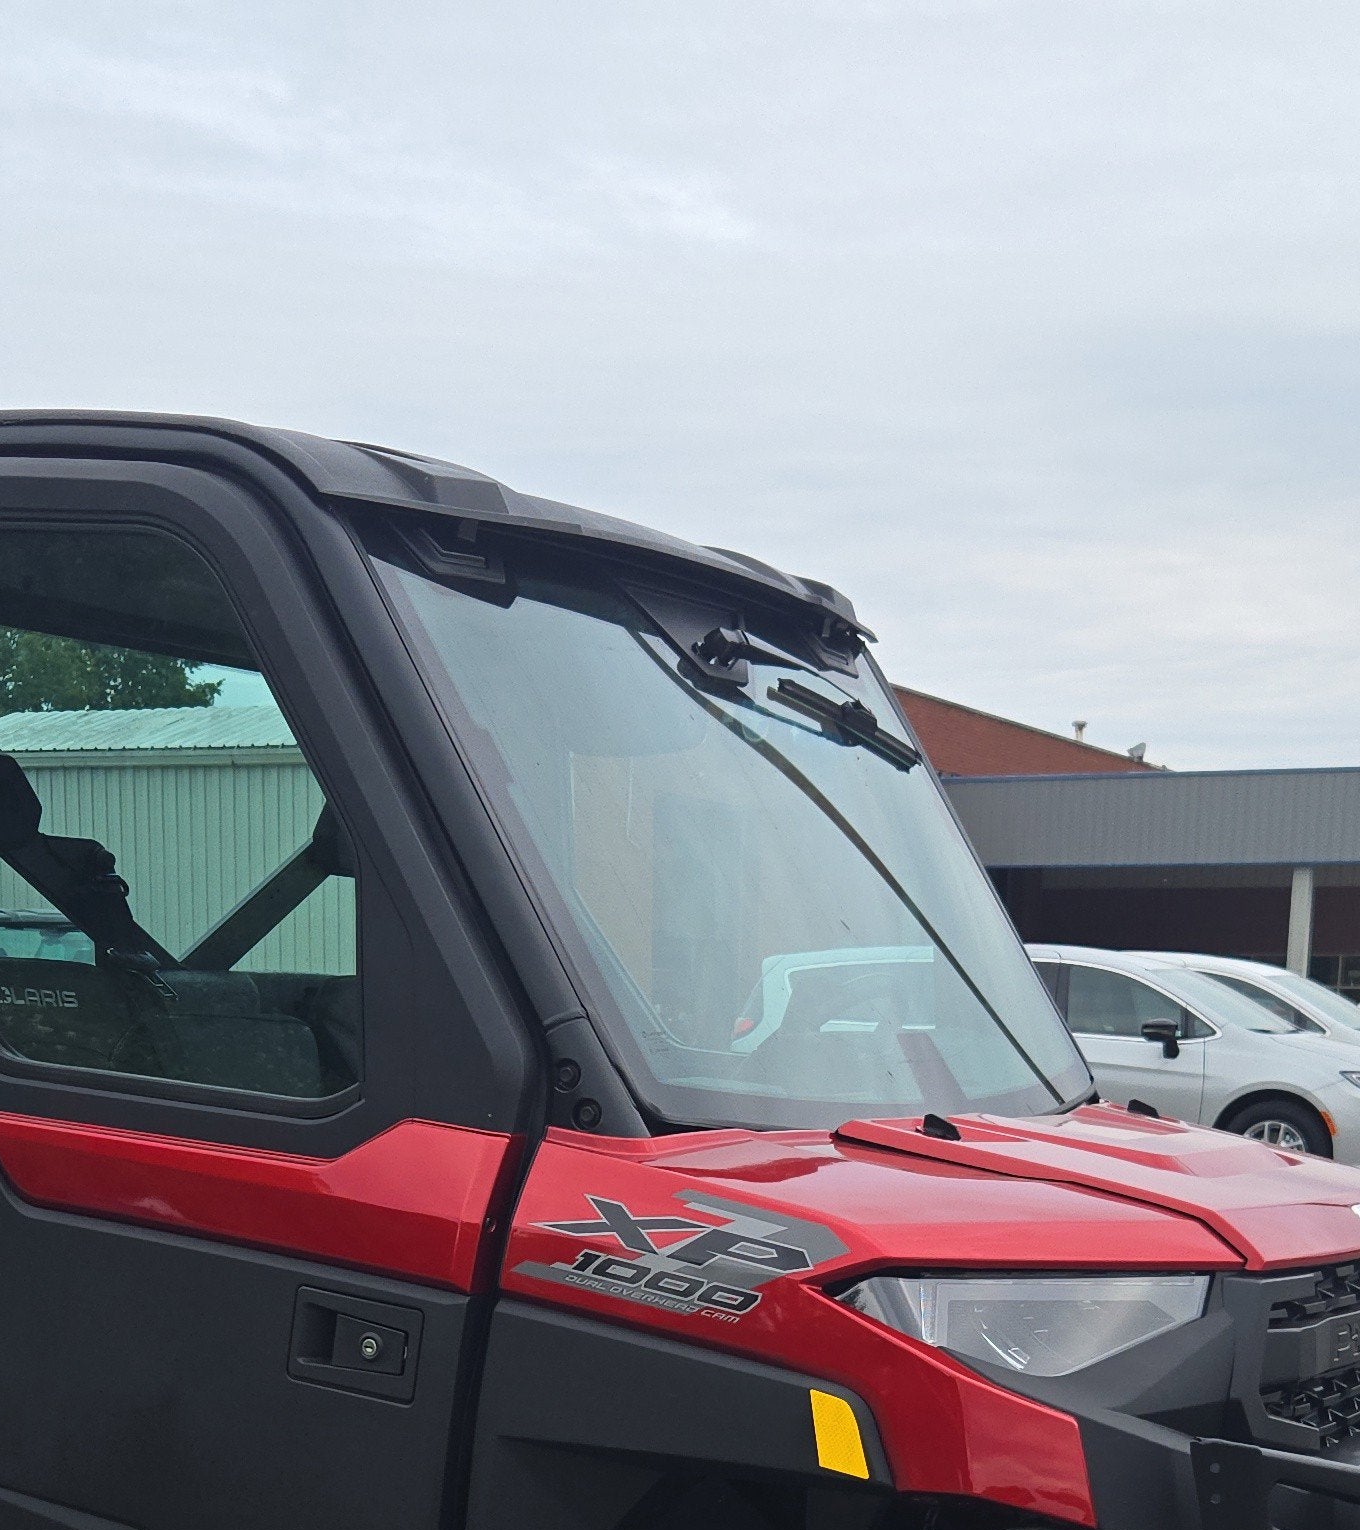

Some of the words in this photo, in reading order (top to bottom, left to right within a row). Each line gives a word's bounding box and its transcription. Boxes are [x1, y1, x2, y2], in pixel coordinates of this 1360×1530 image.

[528, 1193, 814, 1274] XP
[565, 1274, 606, 1291] DUAL
[610, 1286, 699, 1314] OVERHEAD
[700, 1309, 741, 1325] CAM
[568, 1249, 763, 1315] 1000
